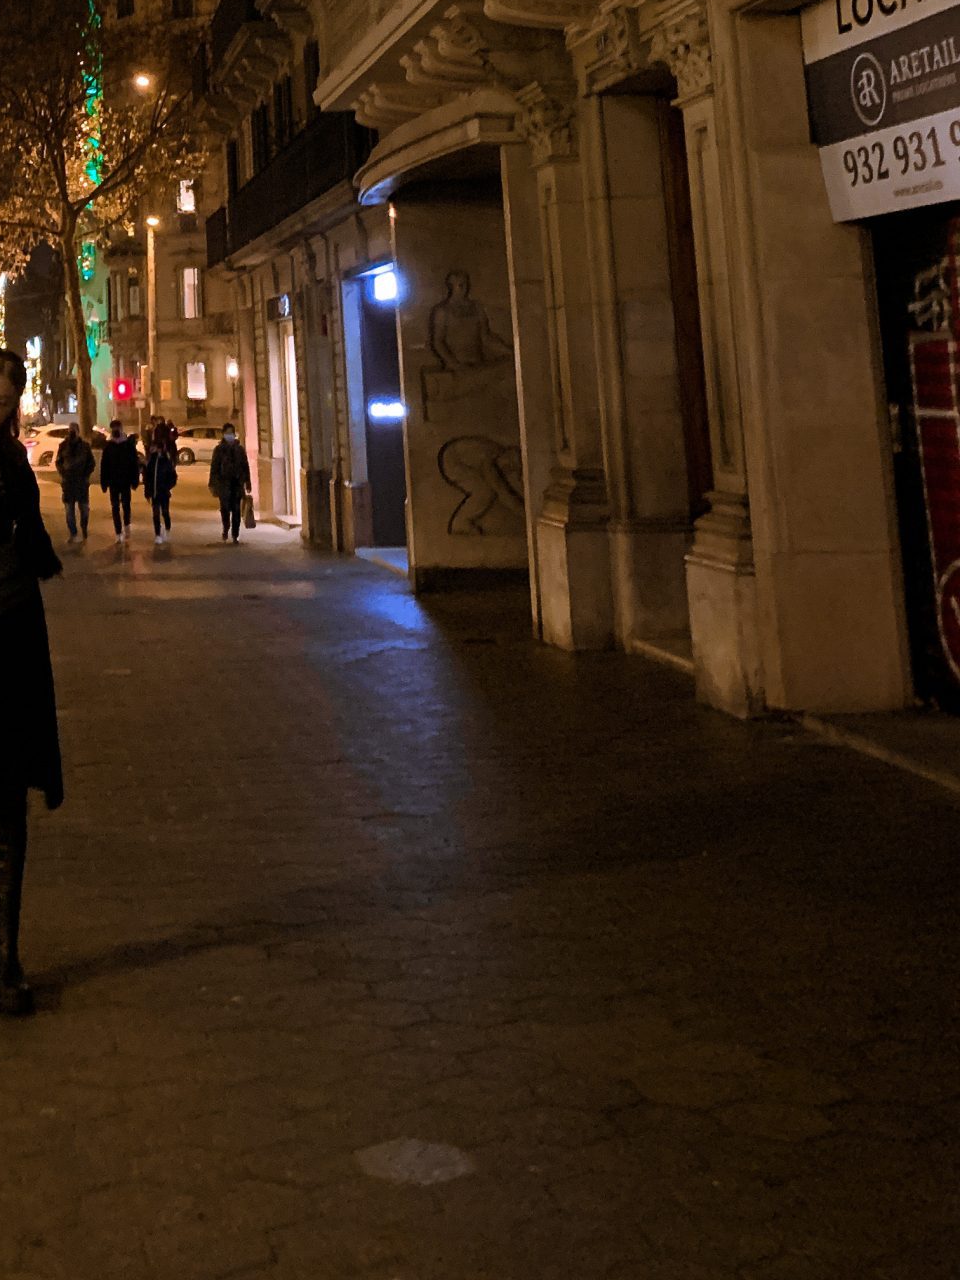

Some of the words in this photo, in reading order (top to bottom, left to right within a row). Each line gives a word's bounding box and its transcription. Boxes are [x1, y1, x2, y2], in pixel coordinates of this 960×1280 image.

[890, 37, 960, 86] ARETAIL
[843, 141, 890, 188] 932
[893, 126, 946, 176] 931
